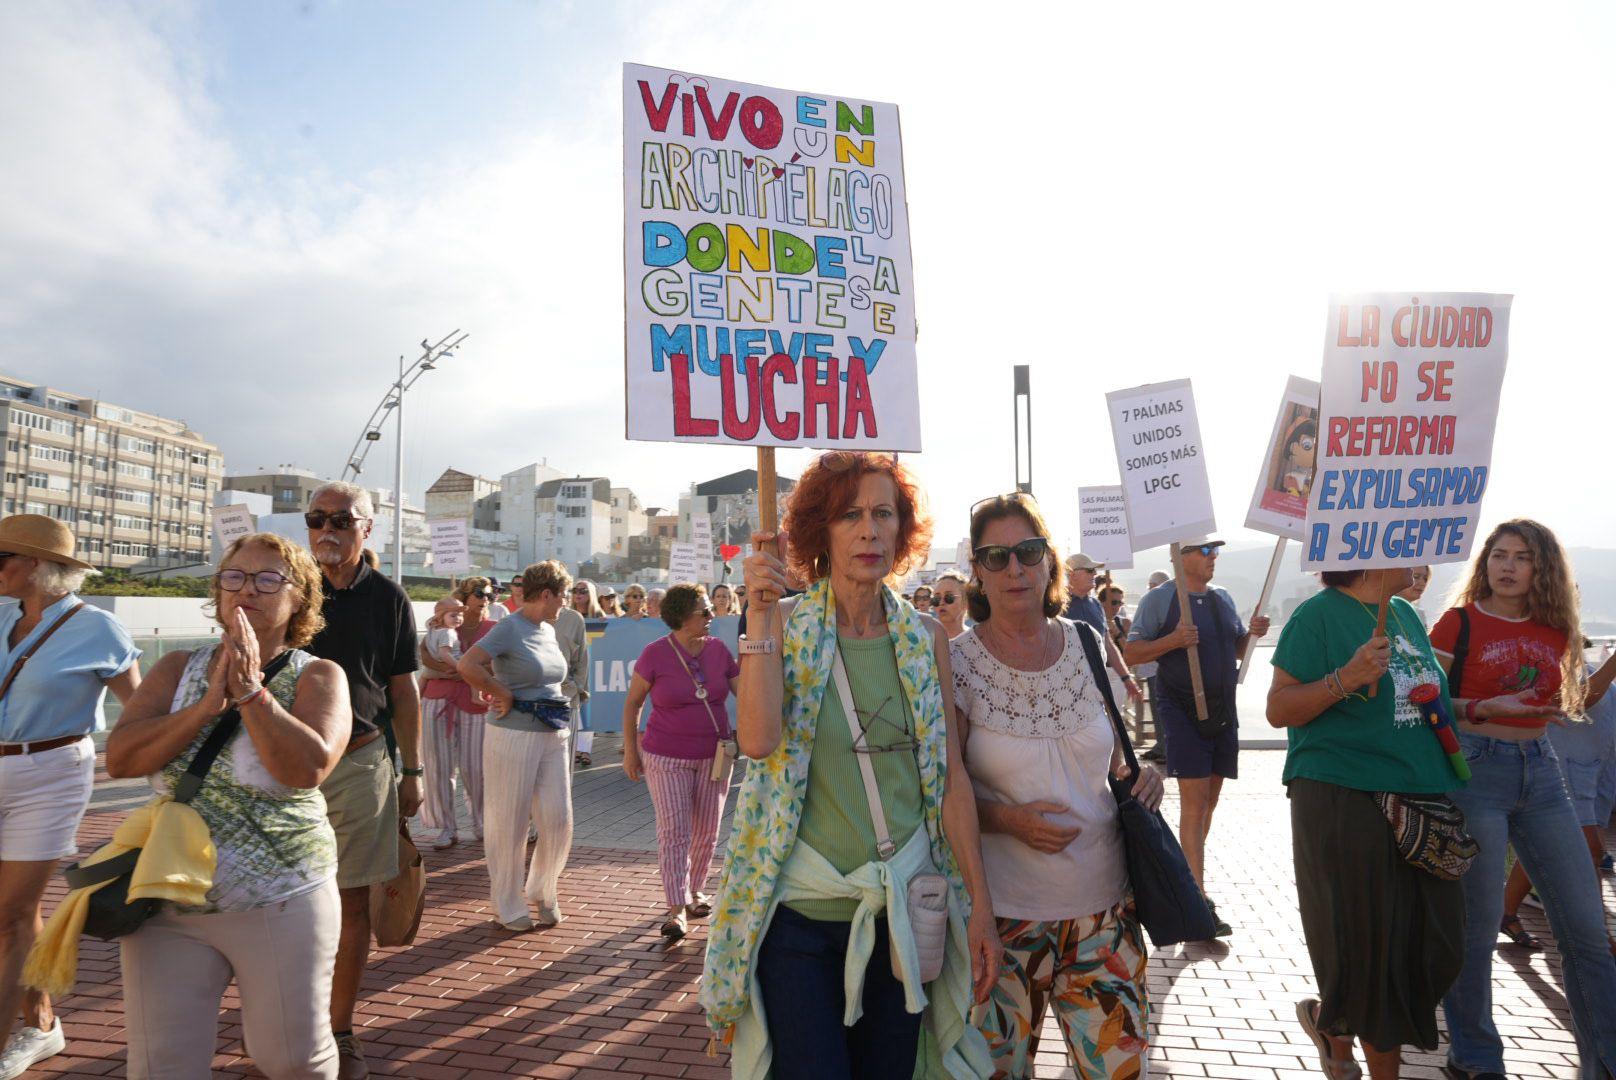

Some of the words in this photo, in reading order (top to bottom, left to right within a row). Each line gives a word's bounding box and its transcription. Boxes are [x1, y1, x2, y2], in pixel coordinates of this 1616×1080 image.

[797, 96, 874, 136] EN
[794, 128, 875, 168] UN
[642, 220, 848, 279] DONDE
[851, 236, 900, 295] LA
[641, 268, 847, 329] GENTE
[848, 275, 896, 334] SE
[1336, 304, 1381, 348] LA
[650, 323, 834, 380] MUEVE
[839, 335, 888, 382] Y
[670, 352, 878, 441] LUCHA
[1360, 360, 1399, 403] NO
[1416, 360, 1455, 402] SE
[1122, 410, 1130, 423] 7
[1133, 400, 1184, 421] PALMAS
[1132, 424, 1182, 446] UNIDOS
[1325, 415, 1457, 457] REFORMA
[1126, 451, 1169, 471] SOMOS
[1170, 444, 1197, 462] MÁS
[1082, 496, 1095, 504] LAS
[1096, 495, 1125, 504] PALMAS
[1143, 473, 1182, 494] LPGC
[1317, 466, 1488, 511] EXPULSANDO
[1083, 529, 1110, 537] SOMOS
[1089, 516, 1120, 524] UNIDOS
[1308, 522, 1330, 561] A
[1338, 521, 1377, 561] SU
[1381, 516, 1468, 559] GENTE
